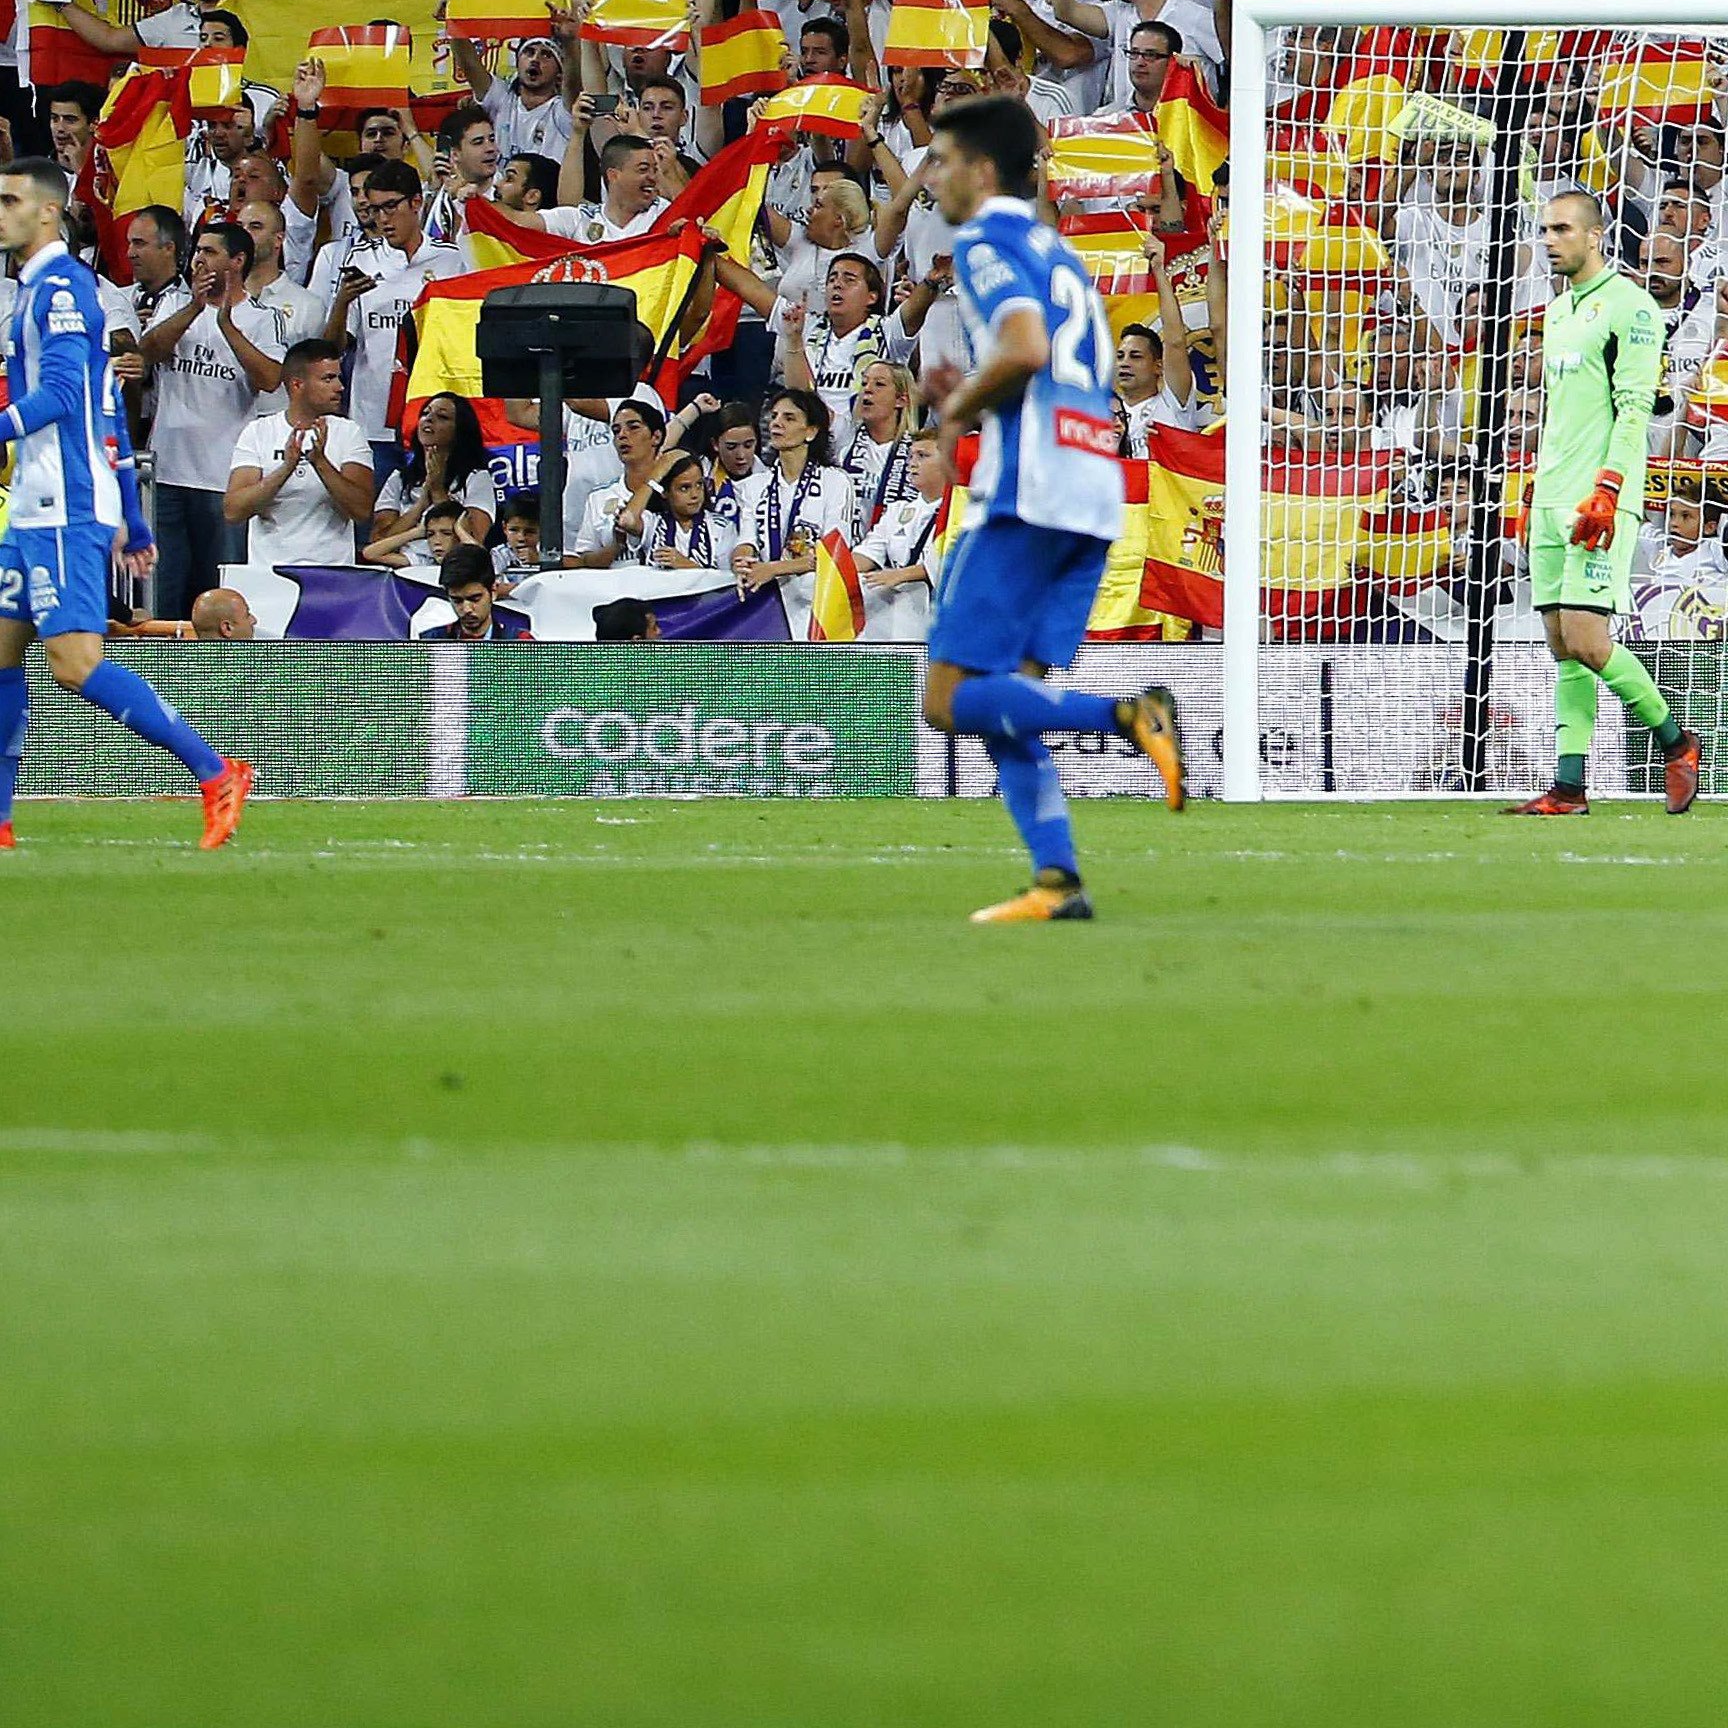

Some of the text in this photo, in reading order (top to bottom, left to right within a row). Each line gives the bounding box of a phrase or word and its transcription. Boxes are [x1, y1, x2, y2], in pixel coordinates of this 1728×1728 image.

[168, 352, 236, 381] Emirates
[194, 345, 215, 361] Fly
[541, 704, 836, 776] codere
